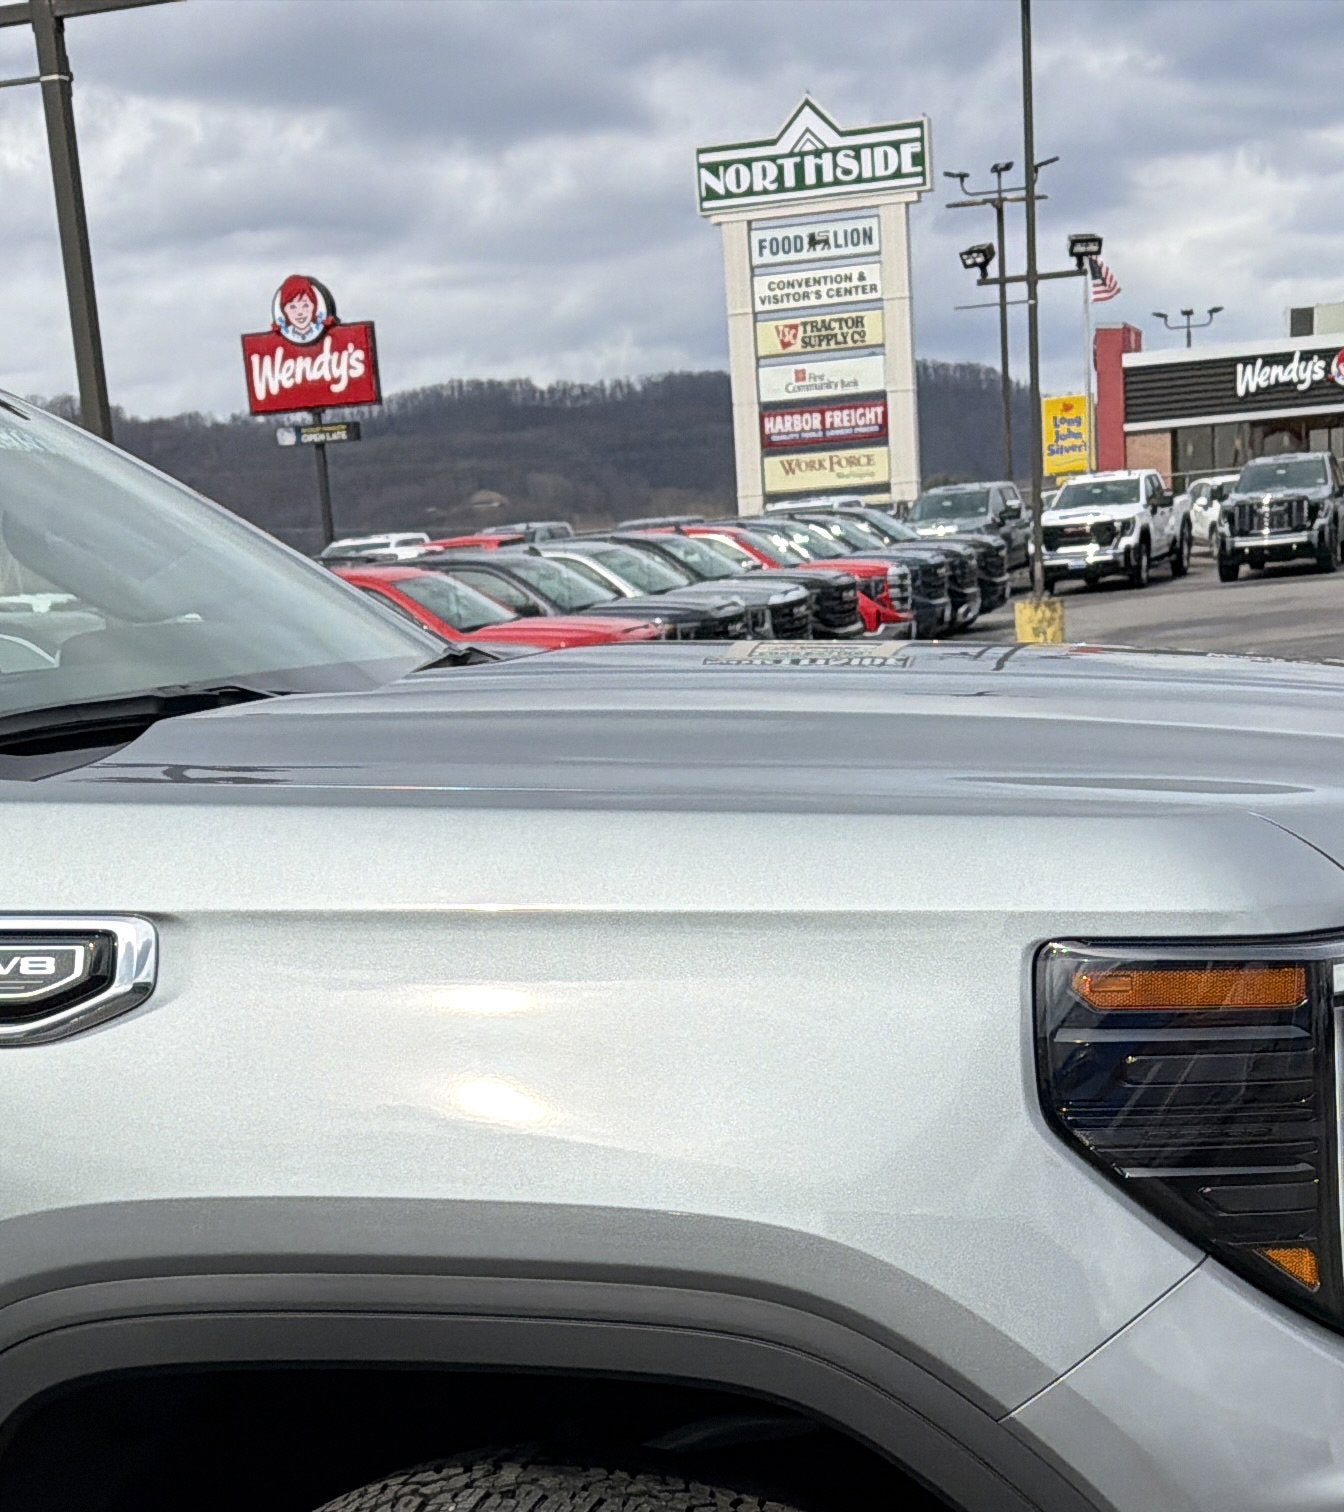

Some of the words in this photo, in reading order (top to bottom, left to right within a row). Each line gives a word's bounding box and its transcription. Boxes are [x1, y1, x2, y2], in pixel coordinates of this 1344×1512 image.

[699, 141, 923, 198] NORTHSIDE
[758, 234, 804, 257] FOOD
[833, 226, 873, 249] LION
[759, 289, 823, 306] VISITOR'S
[826, 283, 878, 299] CENTER
[767, 272, 853, 292] CONVENTION
[857, 271, 867, 282] &
[800, 315, 866, 335] TRACTOR
[800, 331, 849, 349] SUPPLY
[250, 335, 366, 401] Wendy's
[1236, 350, 1327, 398] Wendy's
[764, 412, 822, 435] HARBOR
[825, 406, 884, 430] FREIGHT
